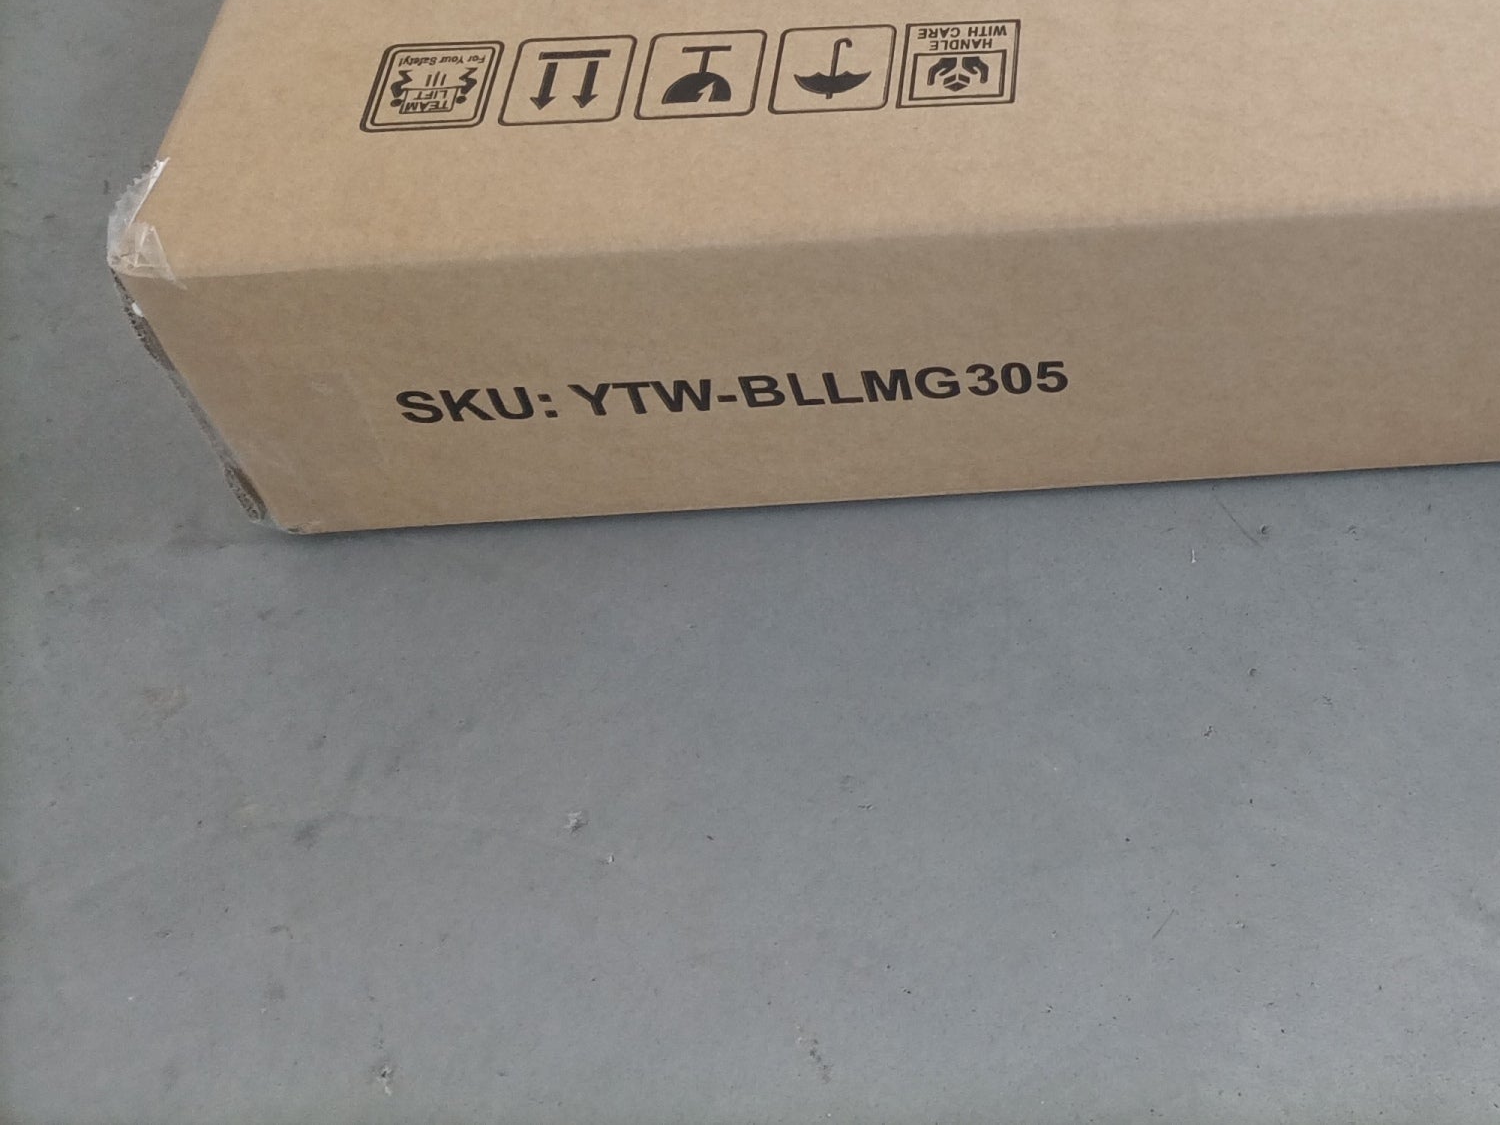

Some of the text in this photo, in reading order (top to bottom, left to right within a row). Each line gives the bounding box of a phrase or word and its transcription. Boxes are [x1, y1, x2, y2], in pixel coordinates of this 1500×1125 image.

[917, 25, 1007, 39] WITH CARE
[929, 38, 992, 51] HANDLE
[398, 55, 487, 67] For Your Safety!
[413, 90, 448, 101] LIFT
[405, 100, 449, 111] TEAM
[396, 361, 1068, 423] SKU: YTW-BLLMG305
